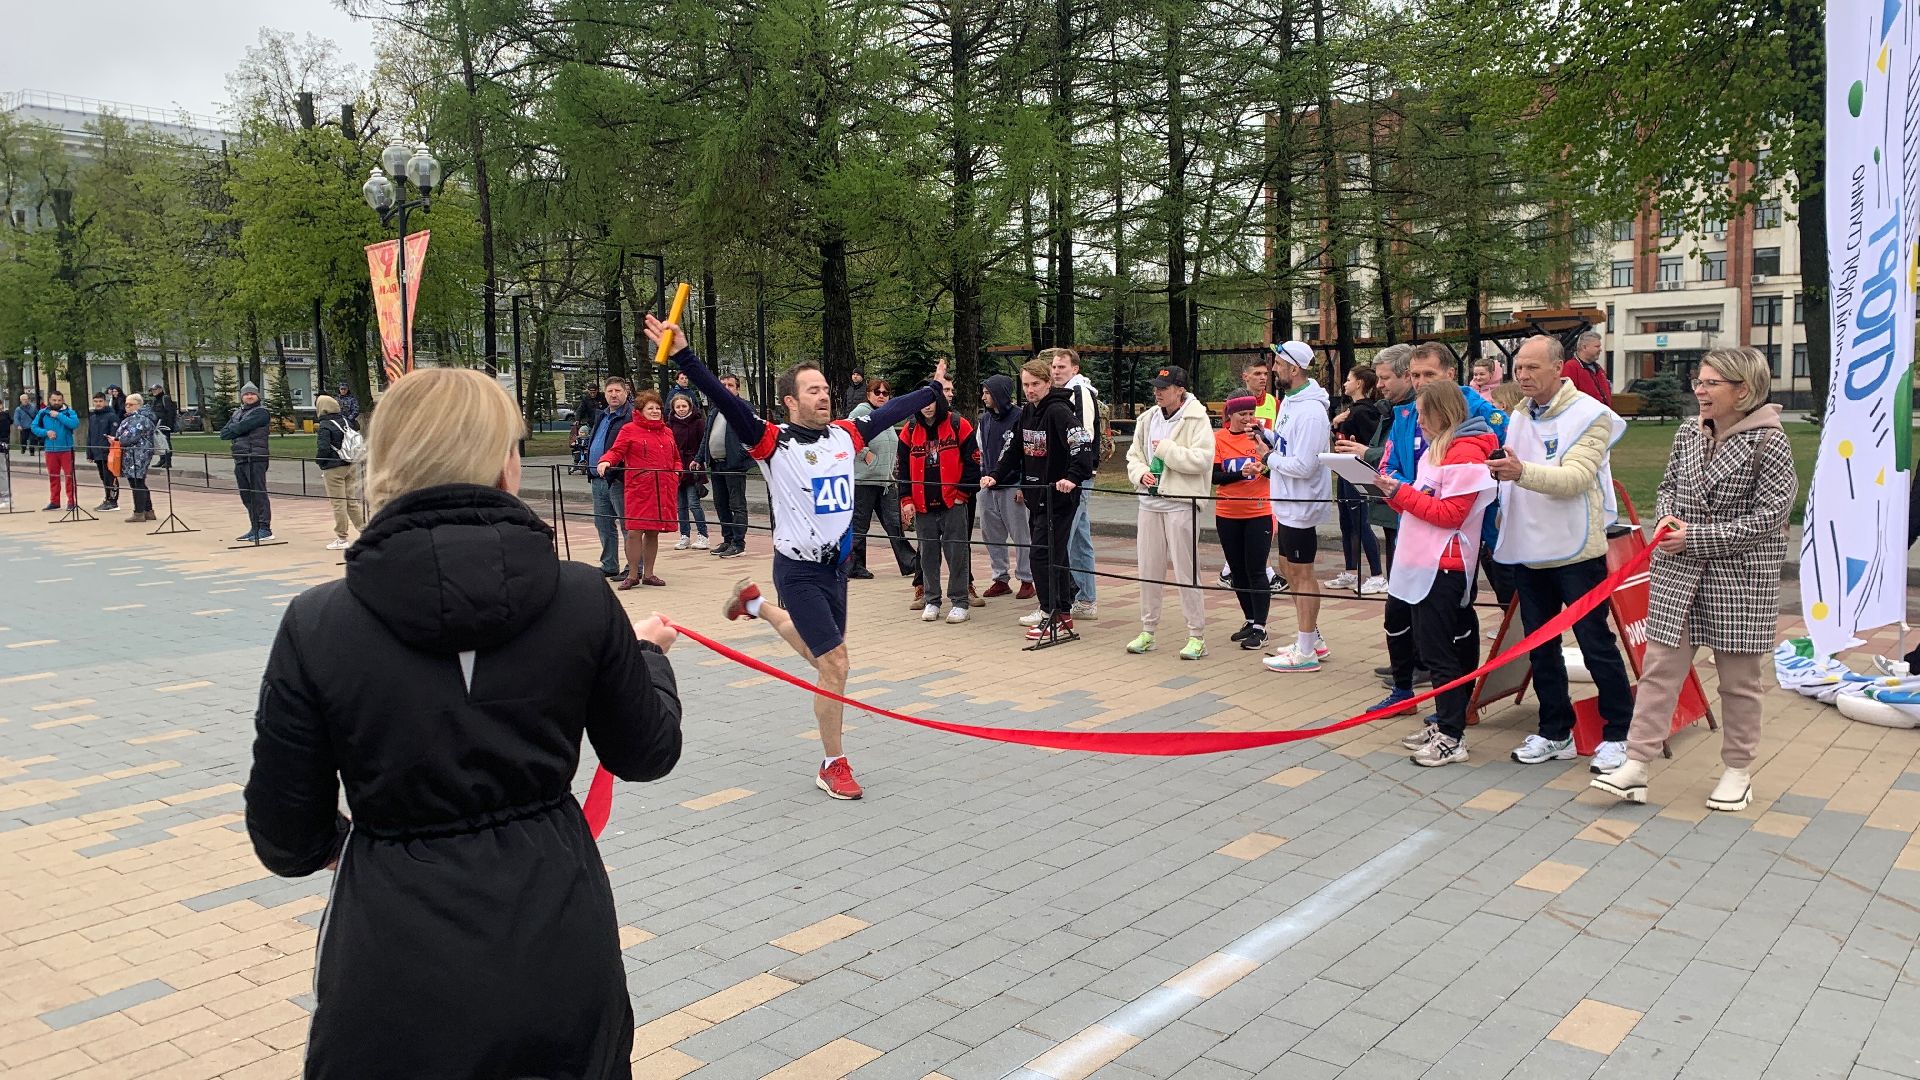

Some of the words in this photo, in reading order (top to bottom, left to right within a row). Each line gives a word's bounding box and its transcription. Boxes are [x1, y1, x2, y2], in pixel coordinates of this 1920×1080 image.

[379, 246, 395, 278] 9
[815, 476, 852, 512] 40
[1624, 617, 1648, 648] ФИН
